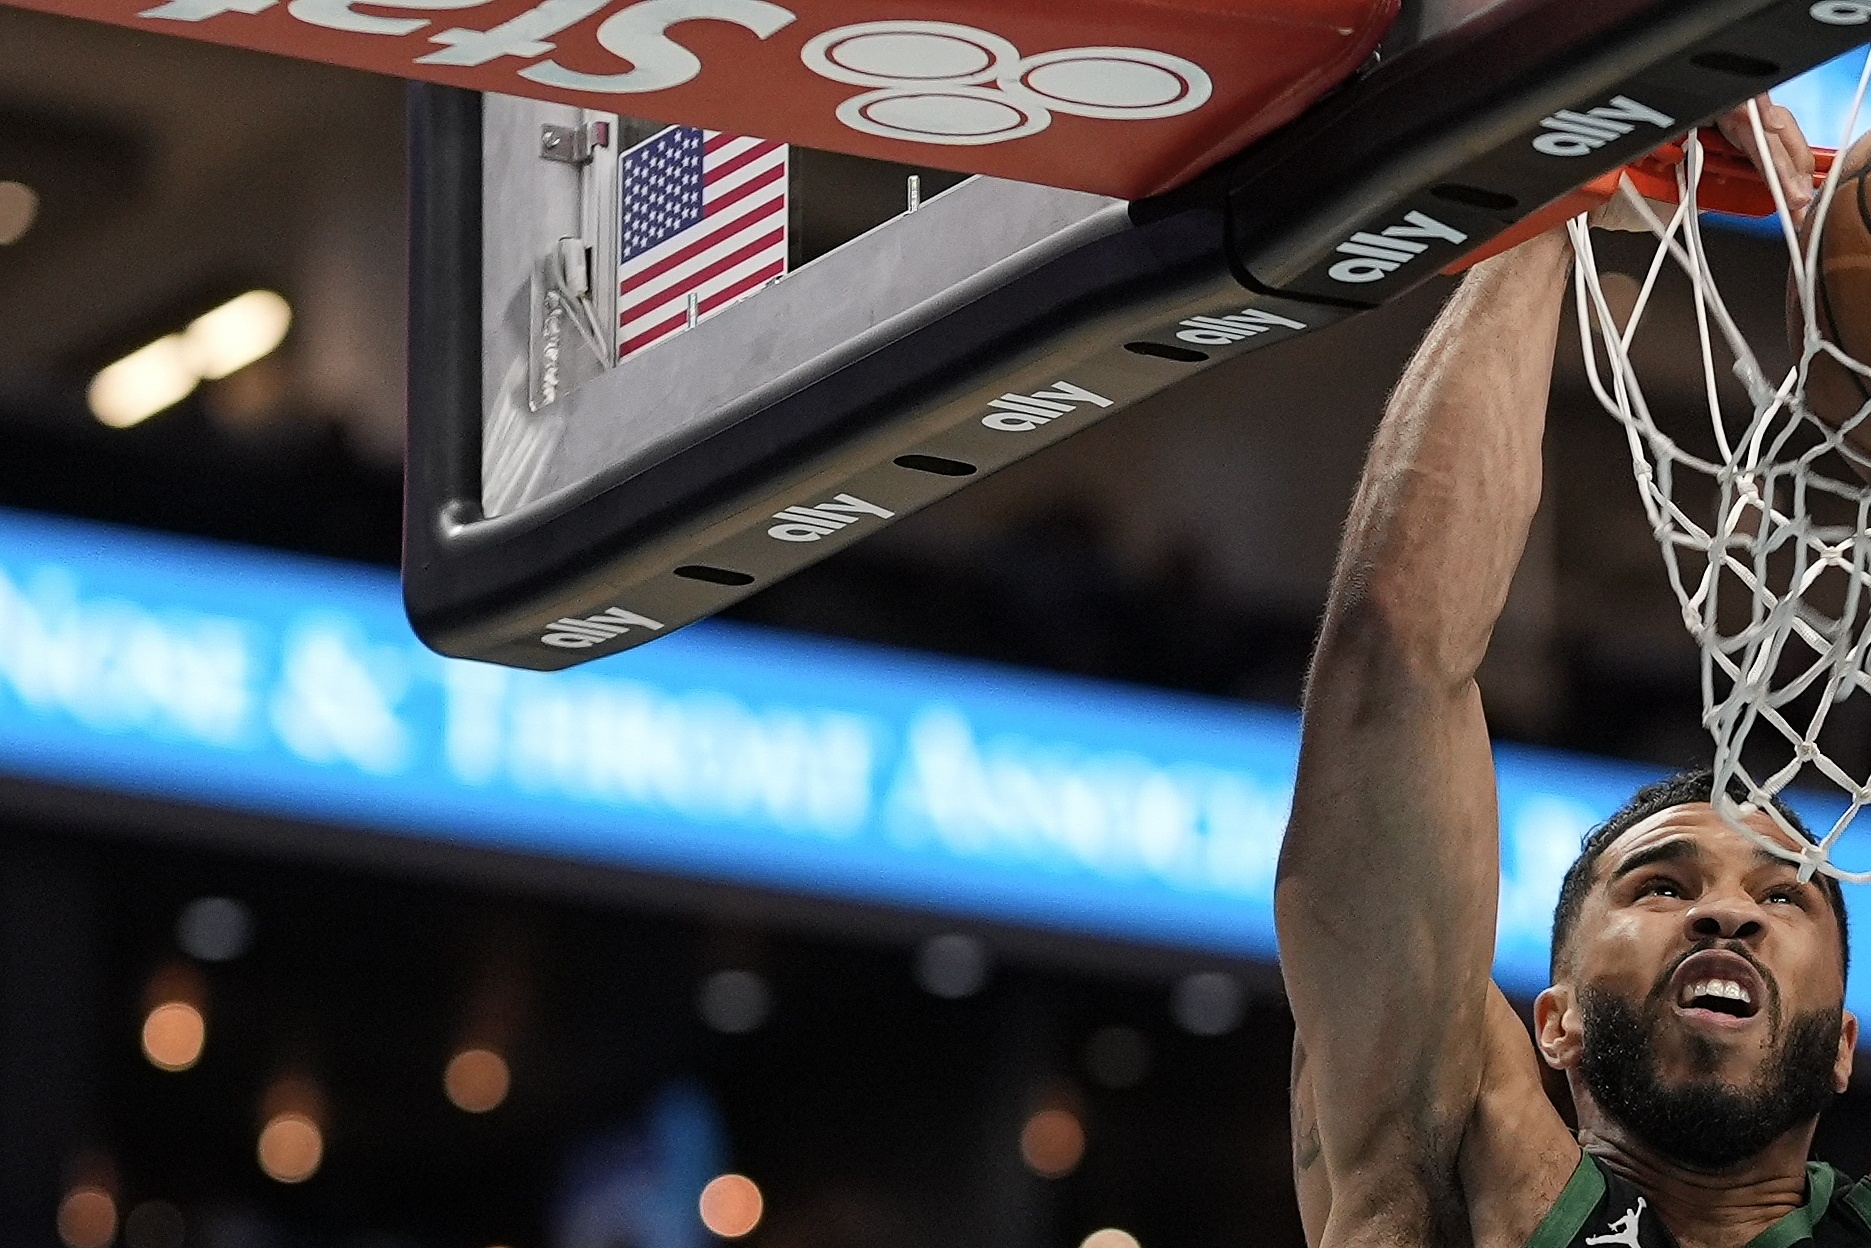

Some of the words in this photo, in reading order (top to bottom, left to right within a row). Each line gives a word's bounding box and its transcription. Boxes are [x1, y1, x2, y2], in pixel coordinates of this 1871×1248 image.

[1532, 95, 1675, 157] ally
[1328, 209, 1468, 284] ally
[1175, 307, 1307, 346] ally
[981, 379, 1115, 433] ally
[767, 492, 896, 543] ally
[541, 605, 665, 649] ally
